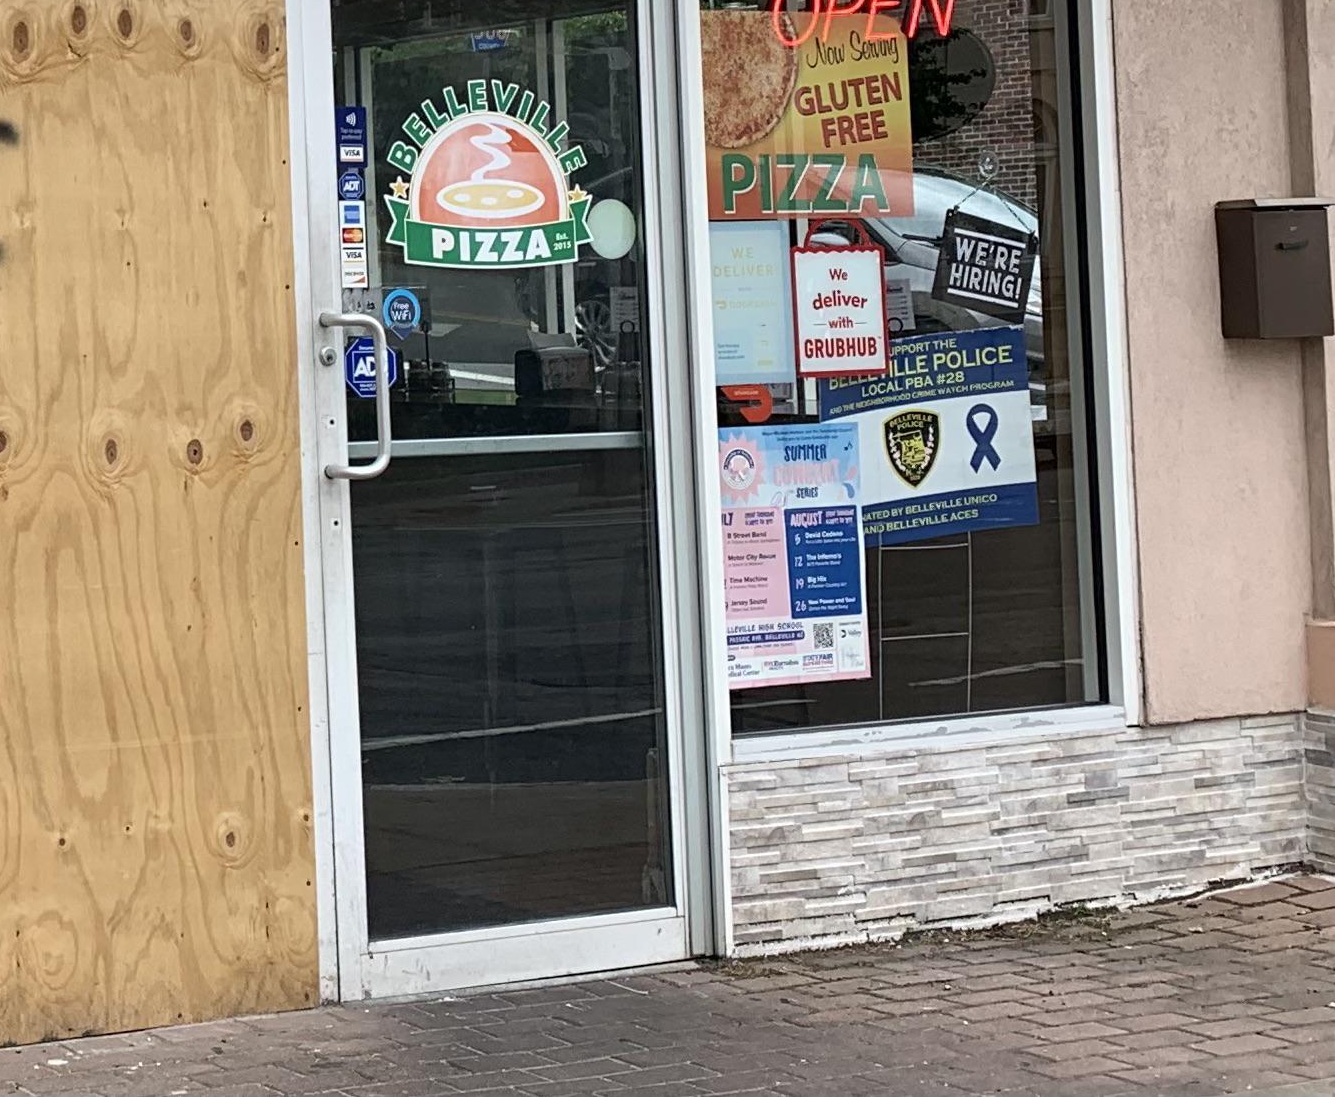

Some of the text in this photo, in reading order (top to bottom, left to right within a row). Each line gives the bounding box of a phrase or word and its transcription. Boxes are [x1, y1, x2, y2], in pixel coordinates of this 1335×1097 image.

[806, 29, 900, 69] Now Serving
[794, 71, 903, 117] GLUTEN
[386, 79, 589, 179] BELLEVILLE
[821, 109, 889, 148] FREE
[344, 149, 361, 157] VISA
[343, 181, 360, 192] ADT
[721, 153, 891, 214] PIZZA
[346, 251, 362, 259] VISA
[431, 228, 553, 262] PIZZA
[553, 241, 572, 251] 2015
[731, 247, 754, 260] WE
[955, 236, 1022, 274] WE'RE
[829, 268, 848, 281] We
[949, 263, 1023, 300] HIRING!
[393, 301, 410, 310] Free
[812, 289, 868, 311] deliver
[828, 316, 854, 329] with
[804, 336, 878, 359] GRUBHUB
[889, 337, 957, 358] UPPORT THE
[933, 344, 1013, 372] POLICE
[861, 371, 965, 398] LOCAL PBA #28
[912, 389, 936, 399] CRIME
[937, 384, 969, 395] WATCH
[969, 379, 1015, 392] PROGRAM
[889, 413, 933, 428] BELLEVILLE
[784, 443, 828, 462] SUMMER
[796, 486, 819, 499] SERIES
[891, 506, 904, 518] BY
[905, 498, 964, 516] BELLEVILLE
[964, 493, 998, 506] UNICO
[790, 510, 823, 528] AUGUST
[863, 508, 979, 536] AND BELLEVILLE ACES
[795, 578, 805, 590] 19
[795, 600, 807, 612] 26
[727, 624, 756, 634] LLEVILLE
